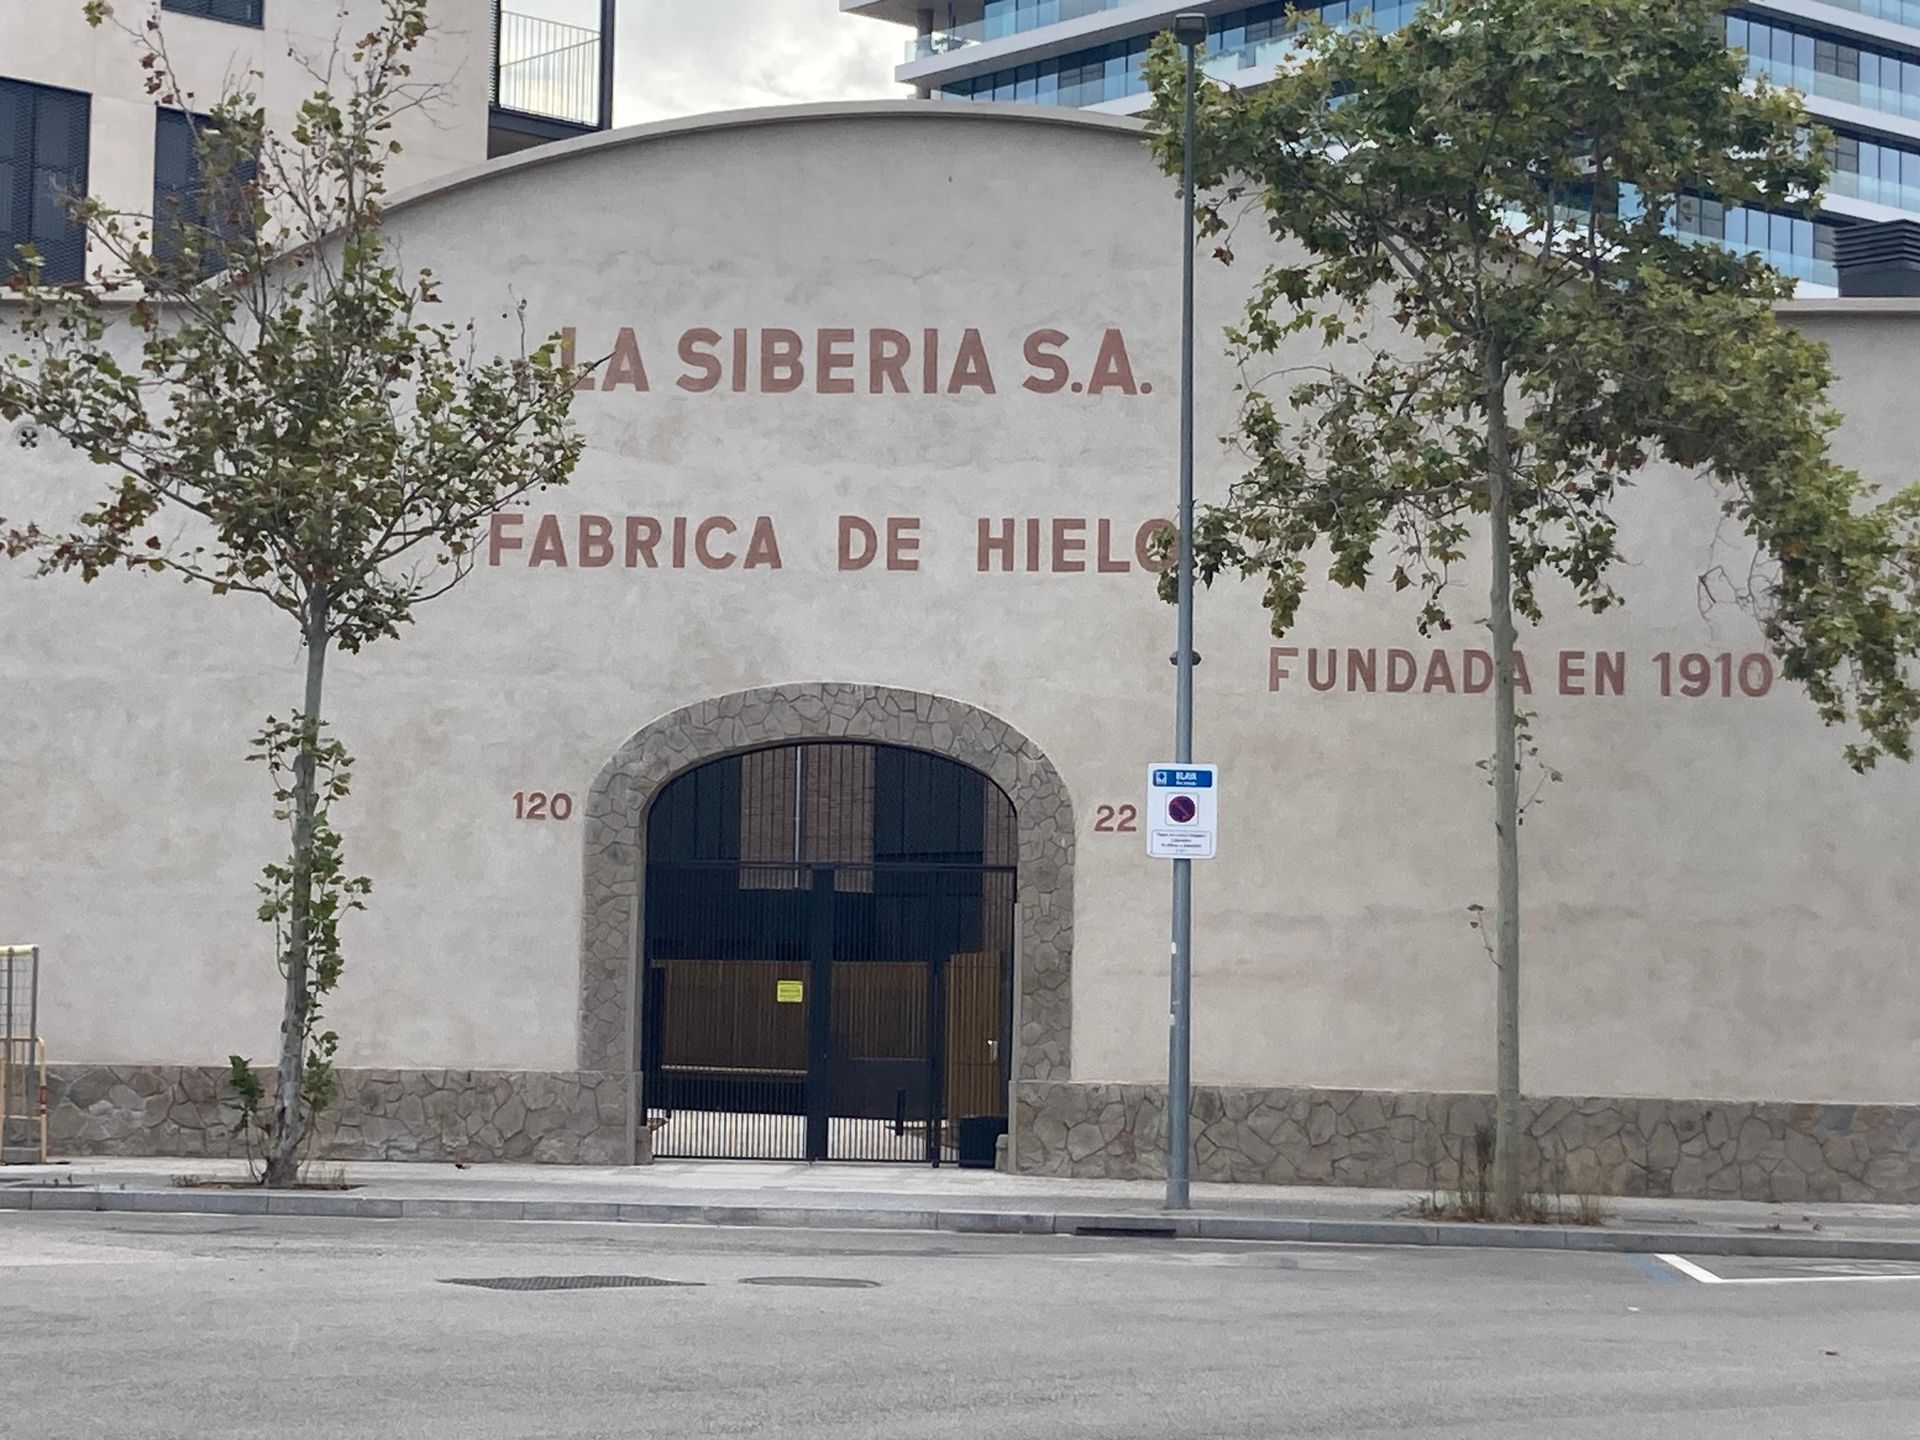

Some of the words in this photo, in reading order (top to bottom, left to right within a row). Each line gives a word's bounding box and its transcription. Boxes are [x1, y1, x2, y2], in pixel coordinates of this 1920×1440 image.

[560, 326, 650, 392] LA
[675, 327, 997, 394] SIBERIA
[1021, 328, 1154, 395] S.A.
[488, 513, 783, 570] FABRICA
[837, 515, 921, 572] DE
[976, 517, 1181, 573] HIELO
[1267, 645, 1533, 695] FUNDADA
[1557, 650, 1626, 696] EN
[1651, 651, 1775, 698] 1910
[512, 791, 572, 820] 120
[1094, 804, 1137, 832] 22
